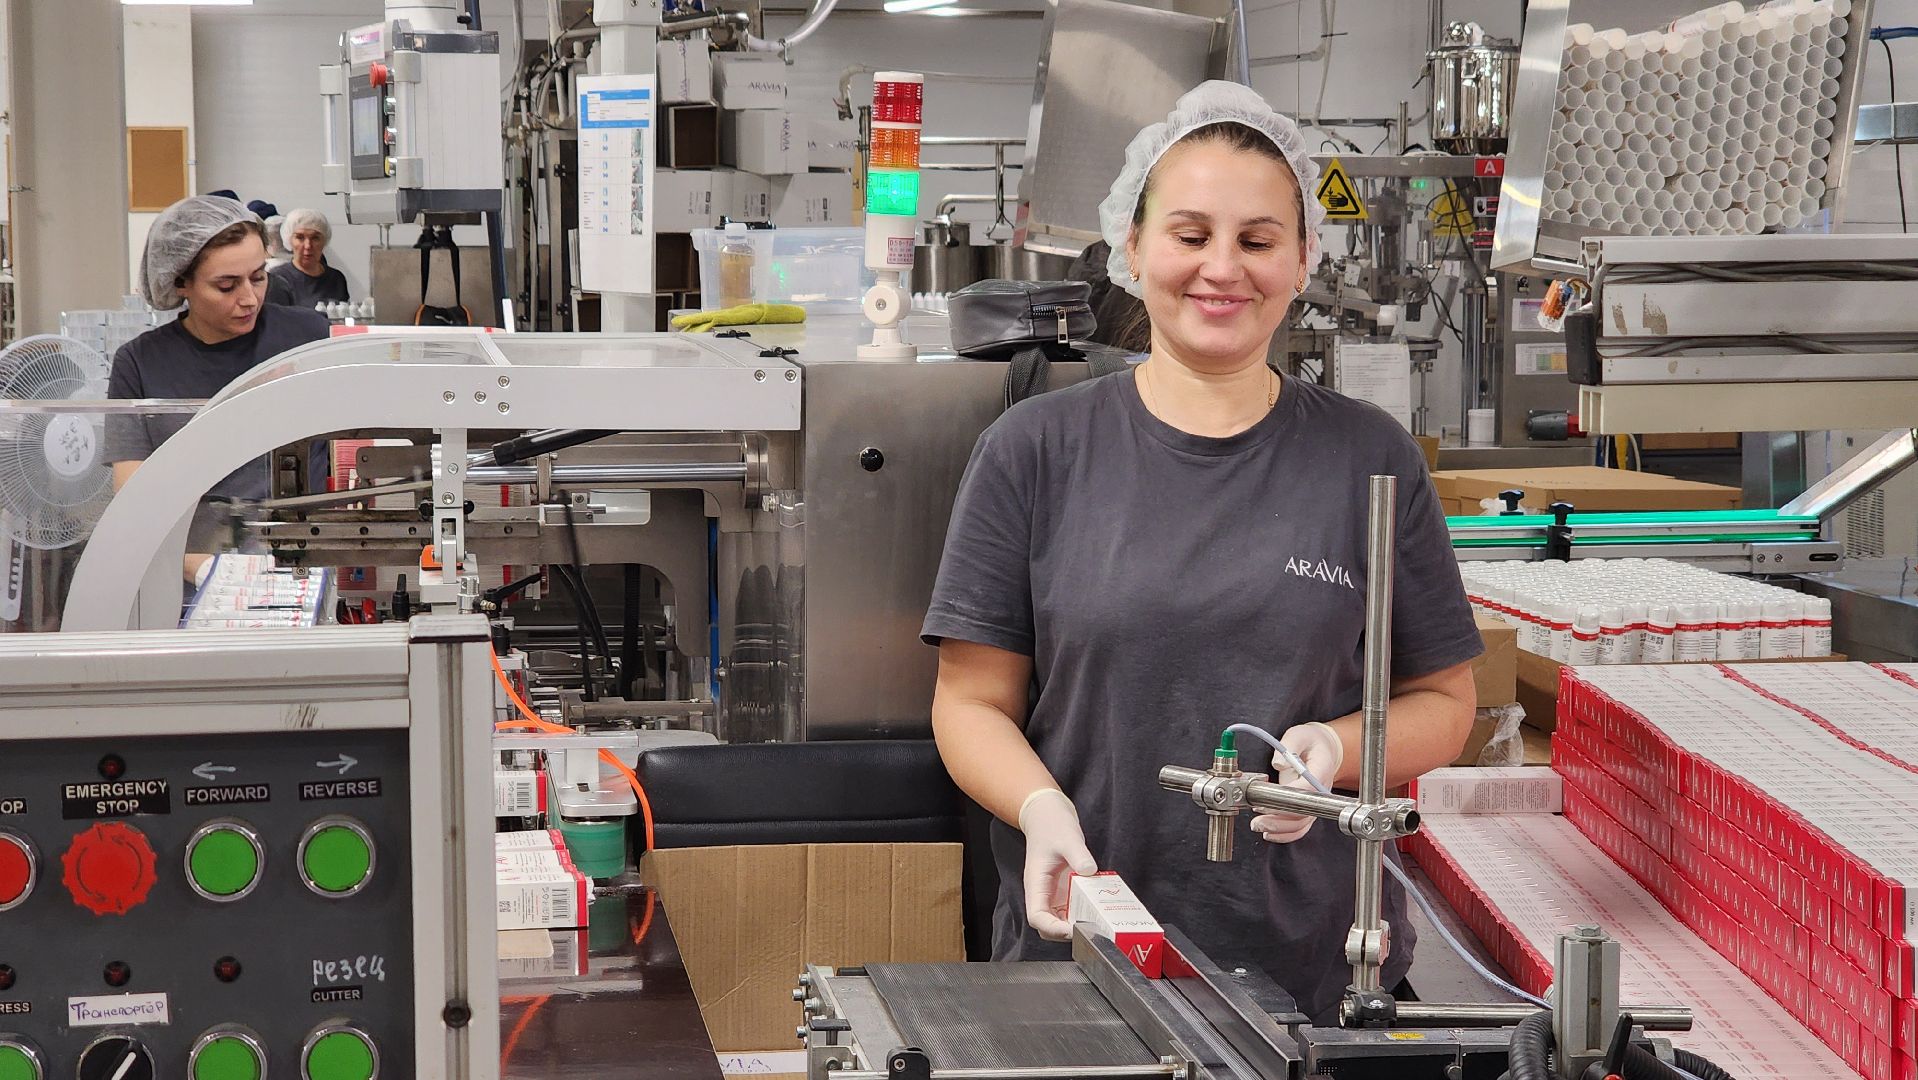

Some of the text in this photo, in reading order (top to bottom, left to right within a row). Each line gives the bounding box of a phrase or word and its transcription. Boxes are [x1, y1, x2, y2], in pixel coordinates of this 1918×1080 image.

[1484, 160, 1496, 174] A
[1285, 556, 1354, 589] ARAVIA
[66, 781, 168, 800] EMERGENCY
[186, 785, 268, 803] FORWARD
[303, 780, 378, 798] REVERSE
[96, 800, 140, 814] STOP
[313, 989, 360, 1001] CUTTER
